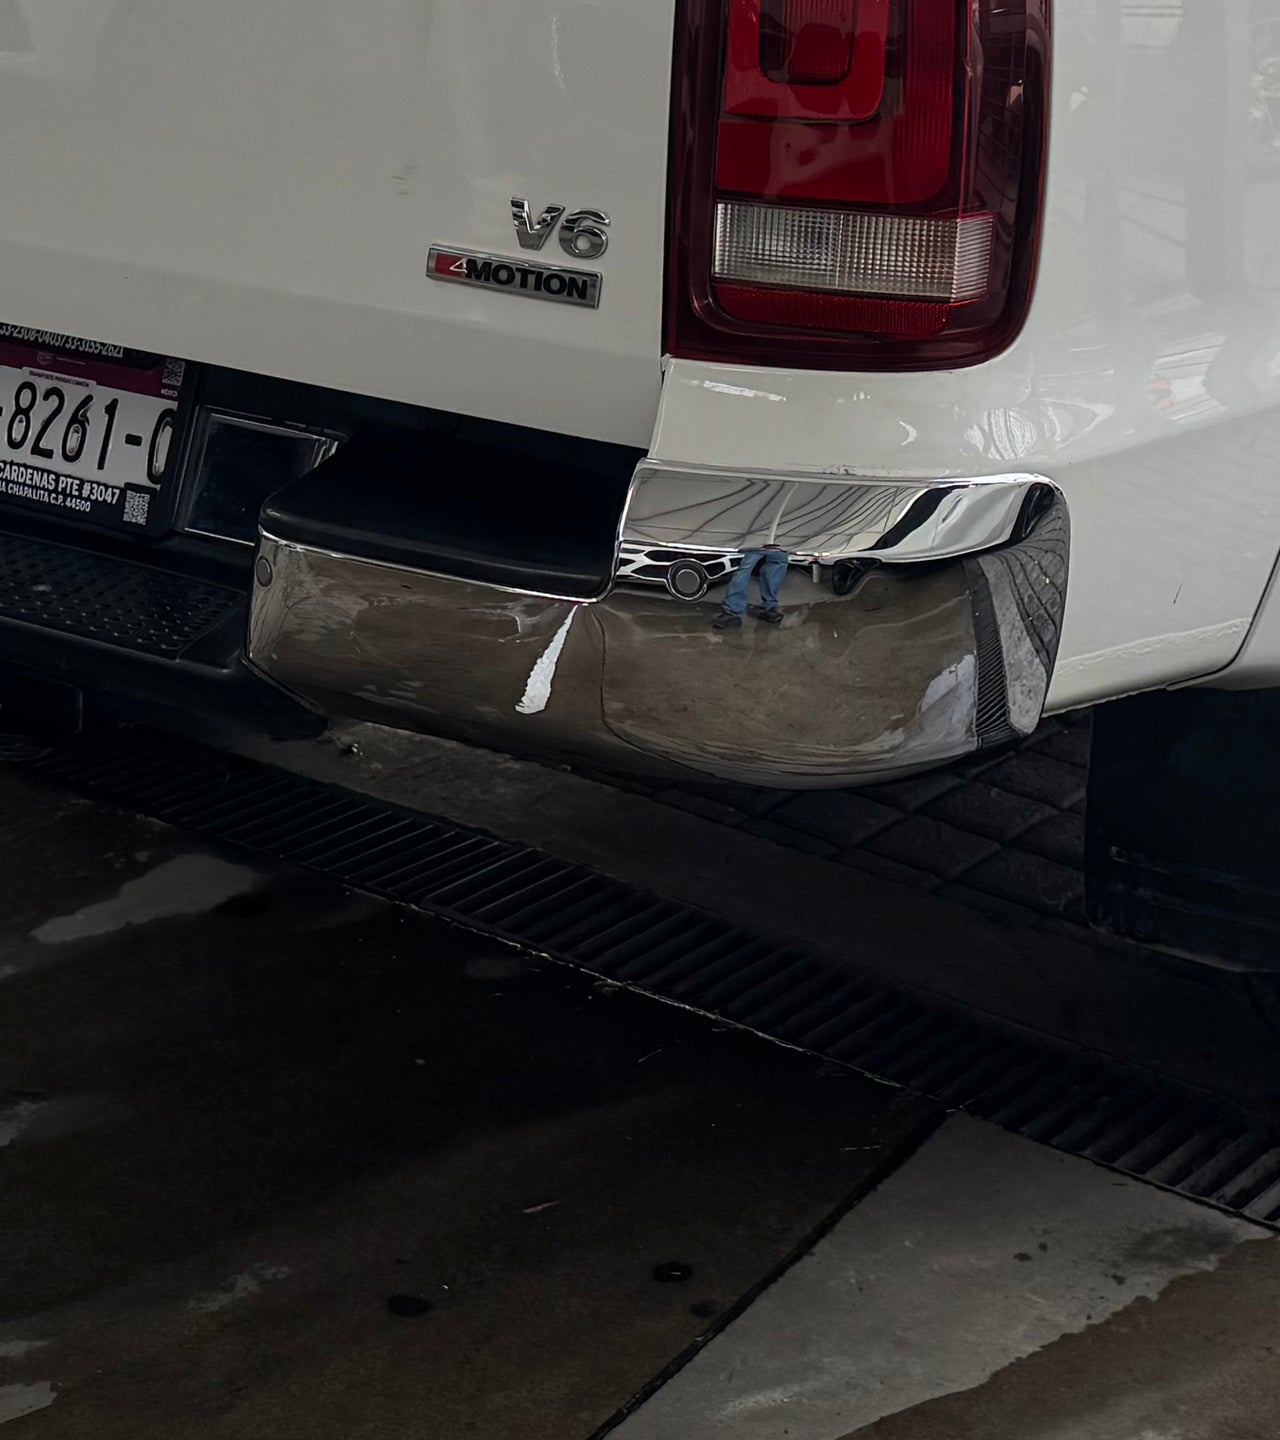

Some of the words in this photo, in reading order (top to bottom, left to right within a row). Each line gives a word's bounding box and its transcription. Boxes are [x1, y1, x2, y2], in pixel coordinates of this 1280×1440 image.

[509, 197, 612, 259] V6
[448, 256, 588, 300] 4MOTION
[7, 482, 49, 503] CHAPALITA
[50, 493, 64, 507] C.P.
[65, 497, 91, 512] 44500
[58, 475, 79, 496] PTE
[82, 481, 120, 505] #3047
